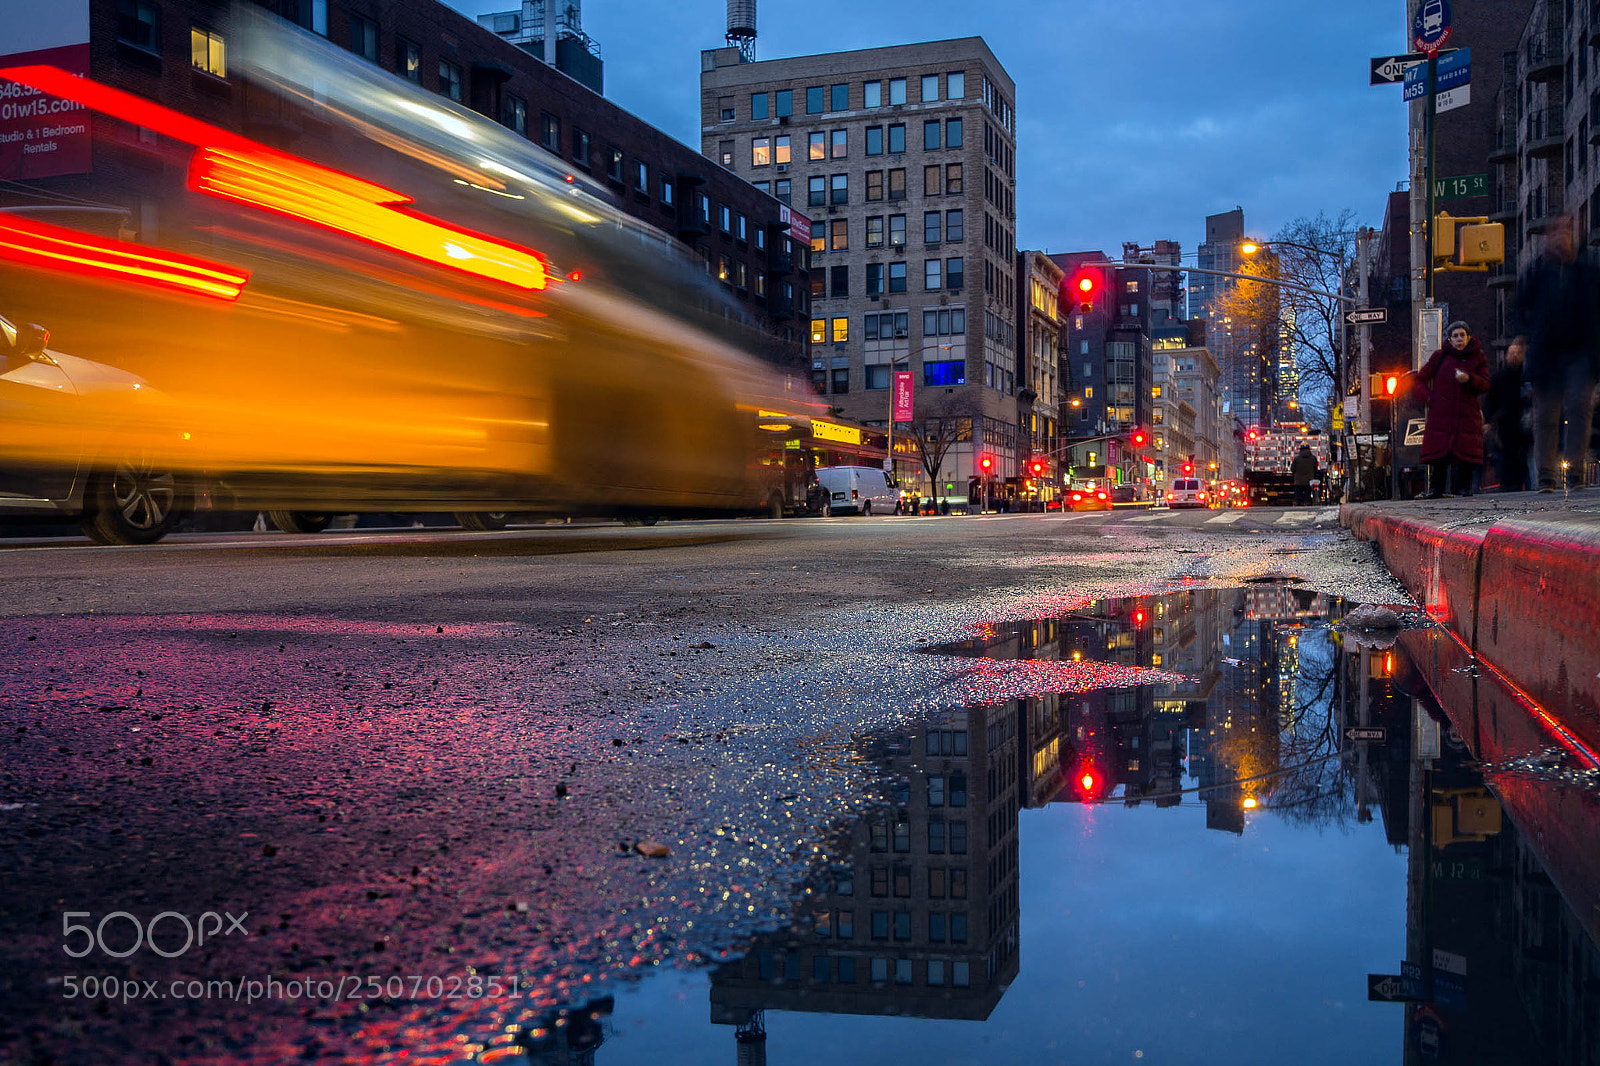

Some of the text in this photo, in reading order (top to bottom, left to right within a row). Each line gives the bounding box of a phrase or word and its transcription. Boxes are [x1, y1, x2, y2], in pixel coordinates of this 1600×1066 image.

[1416, 30, 1449, 50] NO STANDING
[1405, 68, 1418, 82] M7
[1405, 82, 1424, 99] M55
[26, 129, 33, 140] &
[36, 128, 40, 138] 1
[42, 124, 85, 138] Bedroom
[24, 141, 57, 154] Rentals
[1434, 178, 1482, 196] W 15 St
